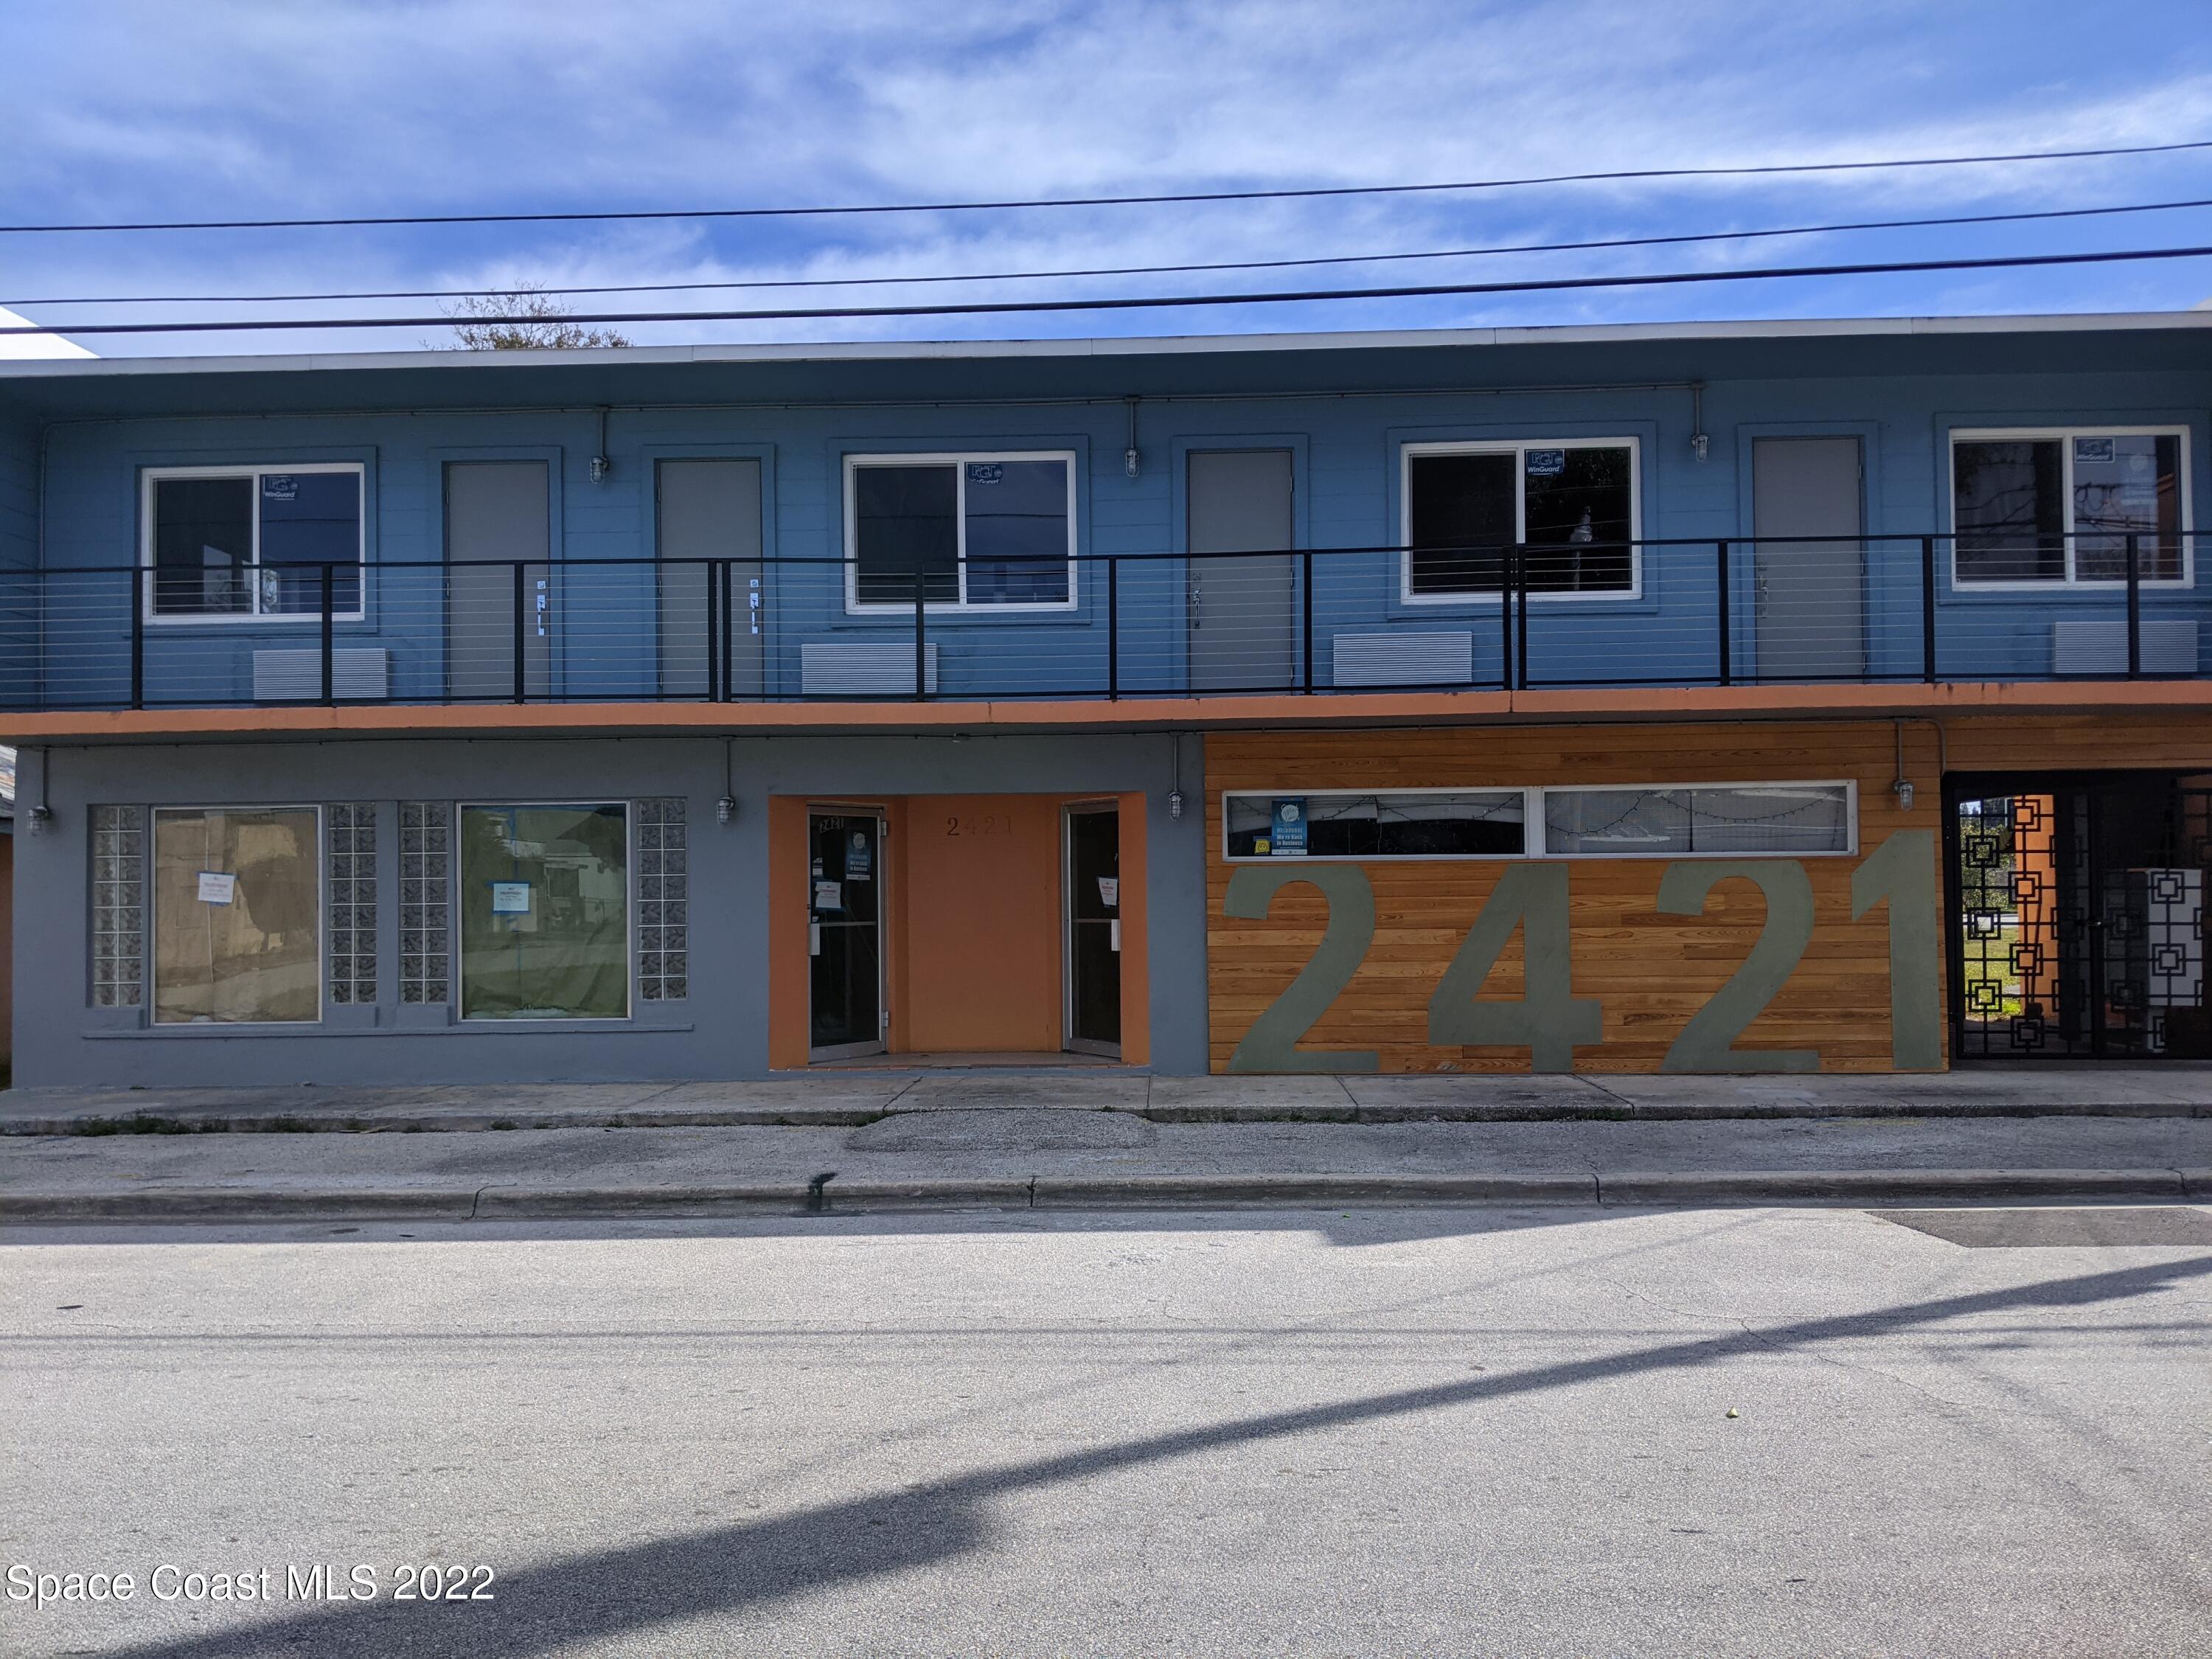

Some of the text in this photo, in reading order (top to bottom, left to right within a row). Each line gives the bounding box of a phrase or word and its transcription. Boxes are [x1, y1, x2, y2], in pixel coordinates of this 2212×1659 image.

[820, 817, 844, 832] 2421
[947, 815, 1013, 836] 2421
[1223, 830, 1942, 1073] 2421
